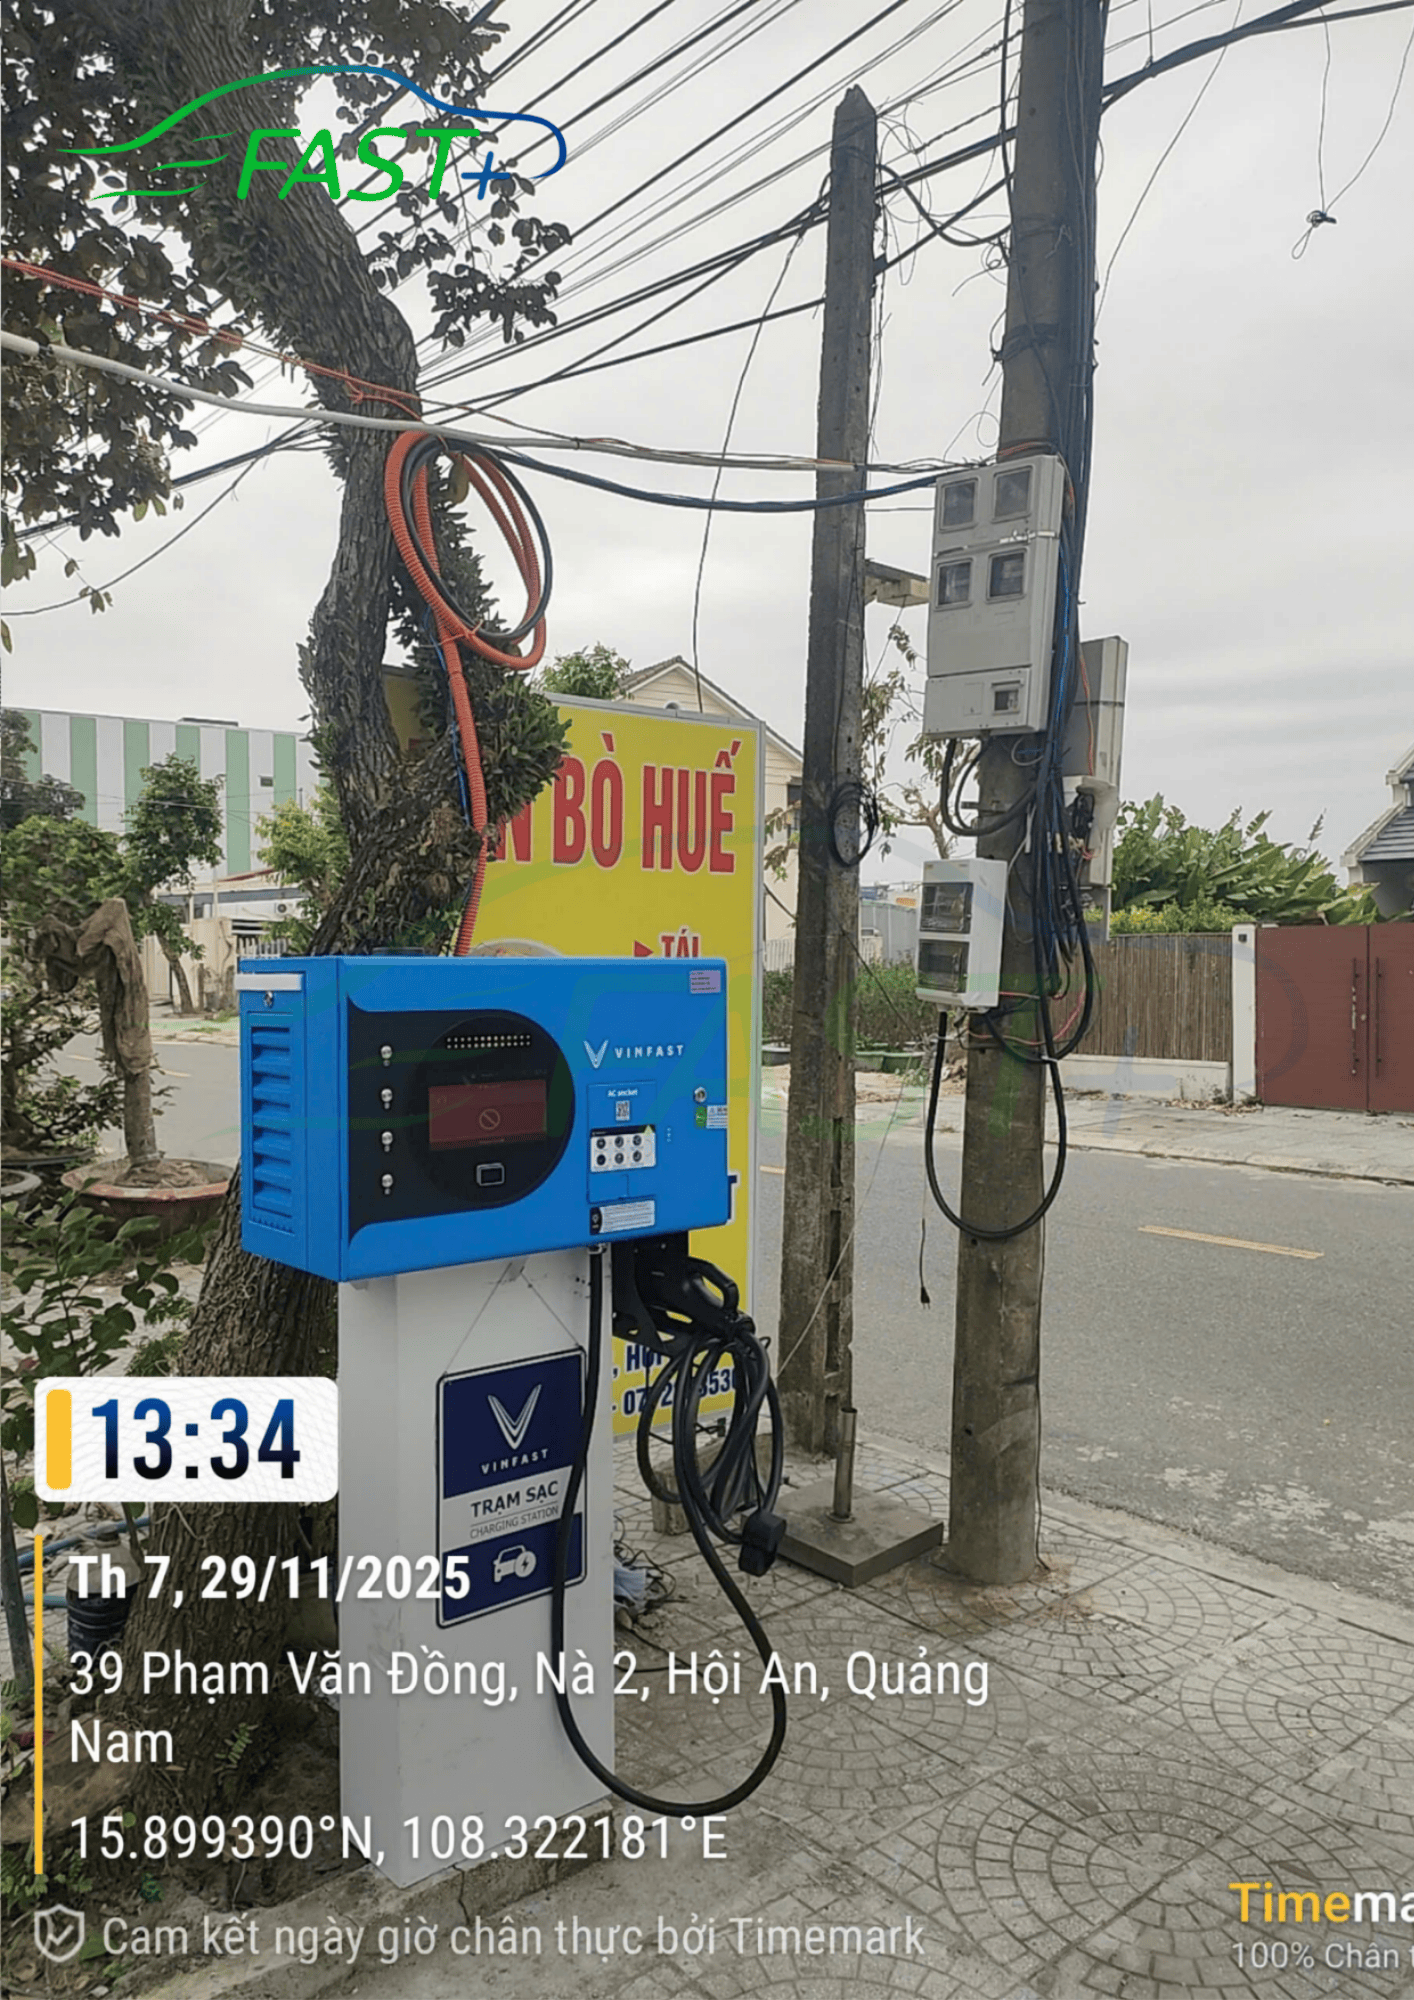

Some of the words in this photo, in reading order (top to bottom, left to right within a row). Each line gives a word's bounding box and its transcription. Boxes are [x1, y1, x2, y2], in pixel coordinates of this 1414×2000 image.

[553, 732, 624, 868] BÒ
[641, 740, 742, 874] HUẾ
[614, 1044, 685, 1059] VINFAST
[481, 1449, 548, 1474] VINFAST
[470, 1490, 521, 1516] TRẠM
[525, 1480, 559, 1504] SẠC
[469, 1516, 519, 1540] CHARGING
[521, 1505, 560, 1525] STATION
